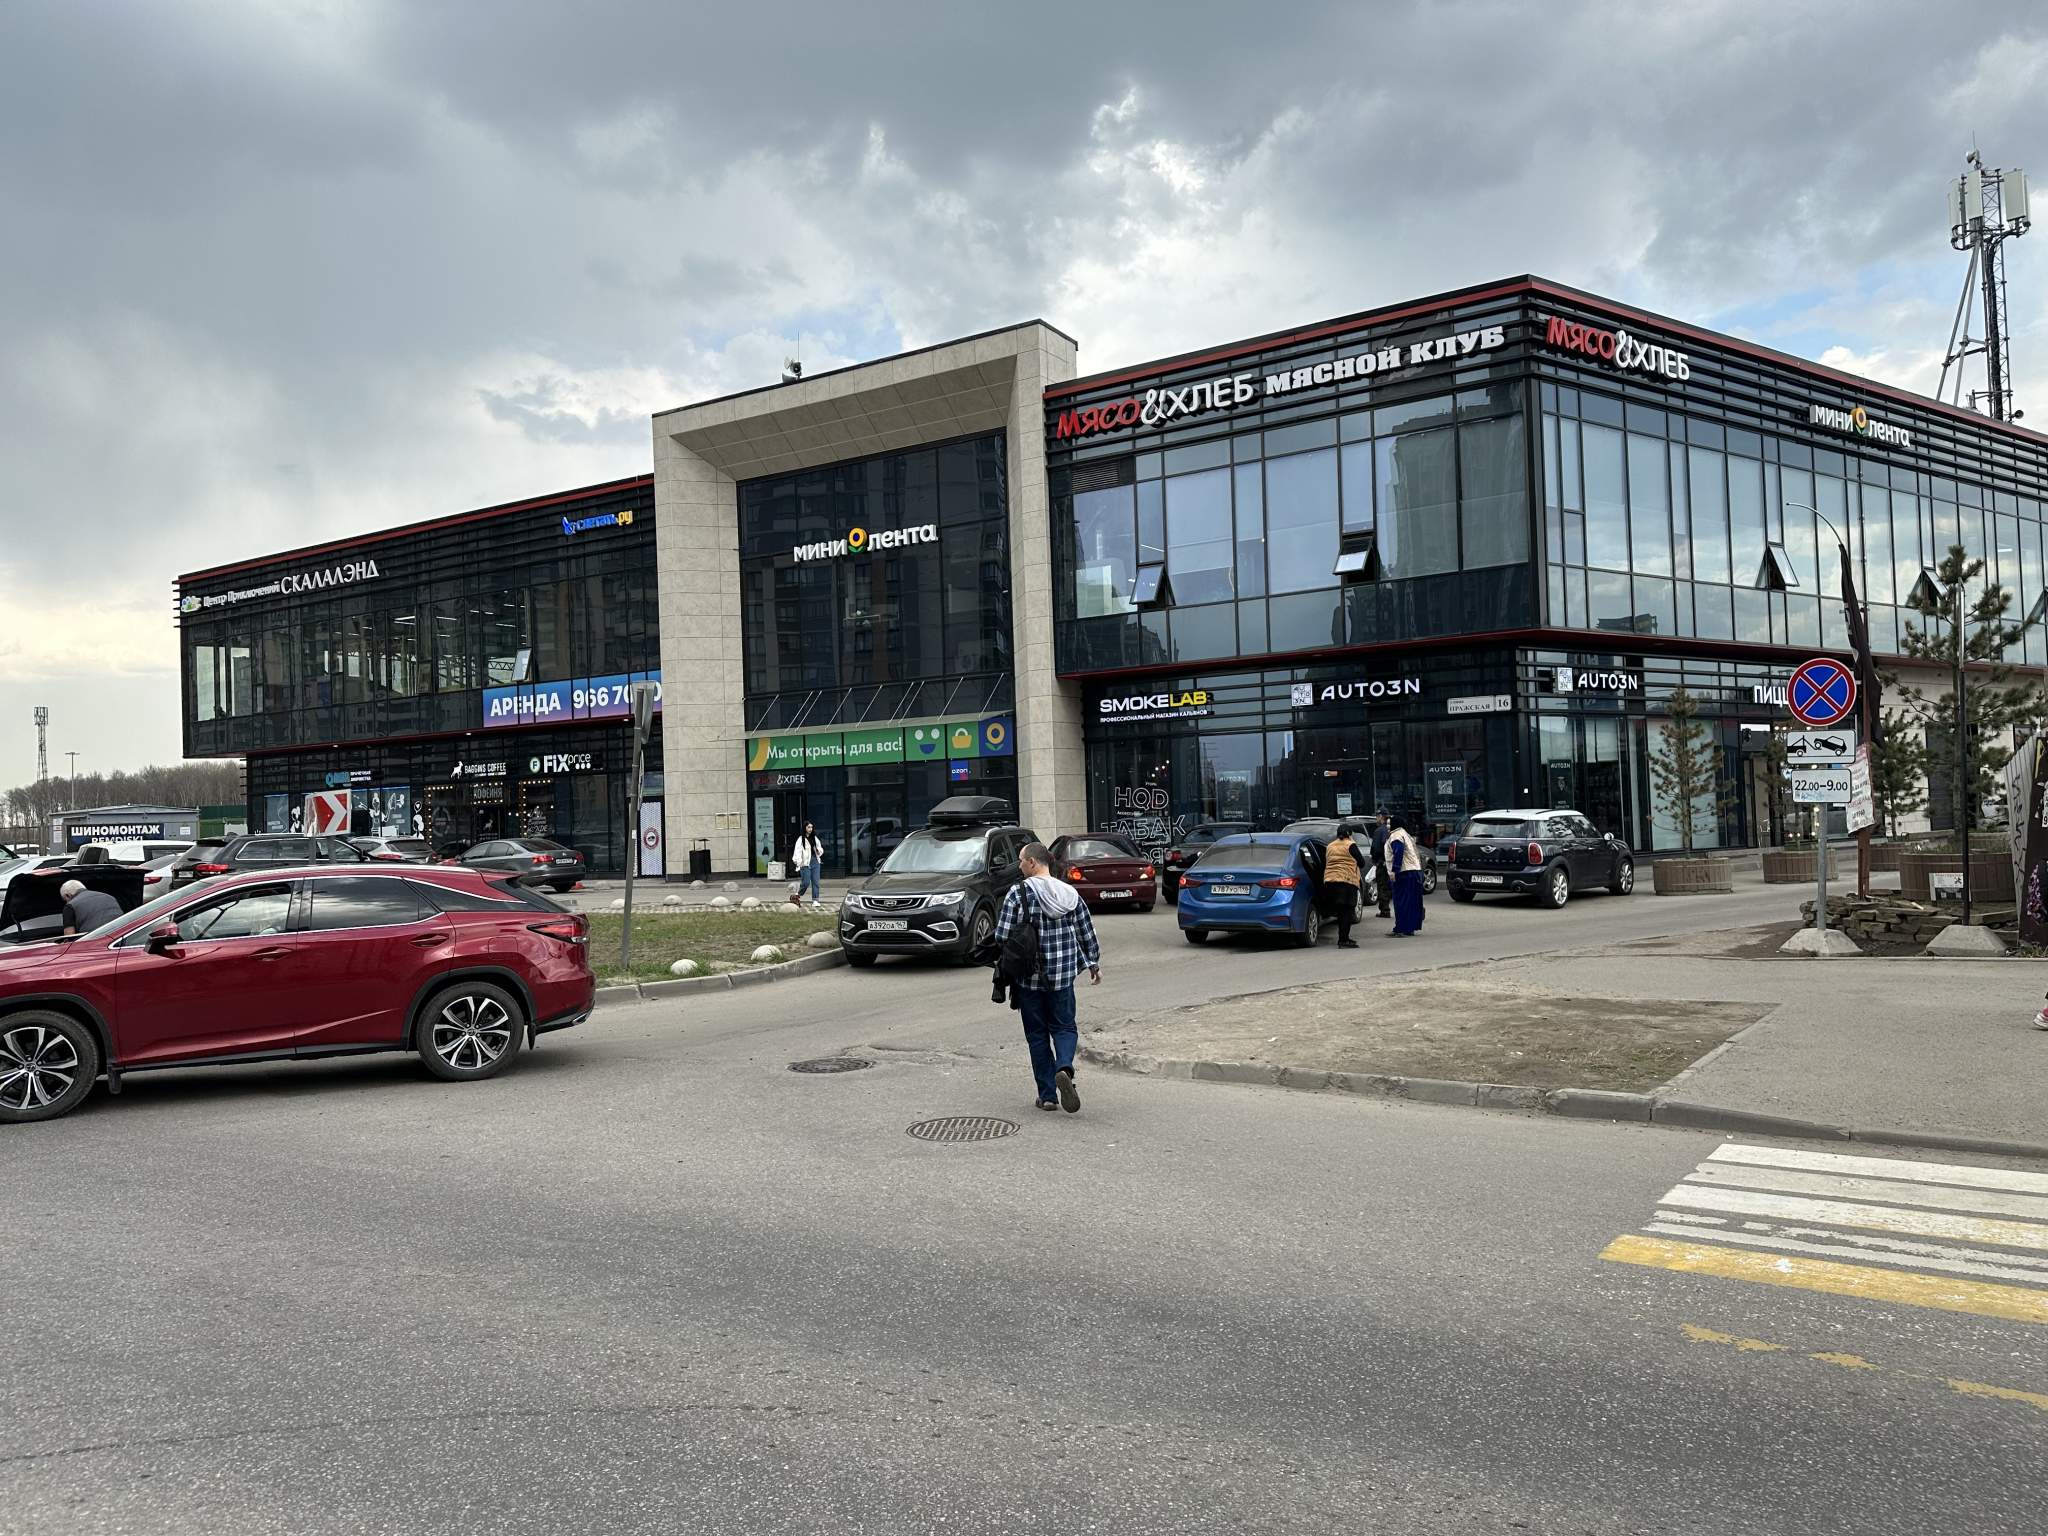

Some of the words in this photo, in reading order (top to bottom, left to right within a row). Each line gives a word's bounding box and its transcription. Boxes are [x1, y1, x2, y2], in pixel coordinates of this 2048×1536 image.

[1265, 345, 1401, 397] МЯСНОЙ
[1410, 325, 1505, 364] КЛУБ
[280, 559, 380, 595] СКАЛАЛЭНД
[1320, 678, 1420, 701] AUTO3N
[1578, 672, 1638, 690] AUTO3N
[490, 692, 562, 717] АРЕНДА
[573, 687, 610, 709] 966
[1498, 699, 1509, 708] 16
[1155, 711, 1179, 719] МАГАЗИН
[767, 745, 787, 759] Мы
[790, 745, 847, 760] открыты
[849, 742, 873, 755] для
[876, 737, 903, 751] вас!
[487, 762, 507, 773] COFFEE
[1428, 765, 1462, 773] AUTO3N
[1114, 786, 1169, 811] HQD
[71, 824, 160, 836] ШИНОМОНТАЖ
